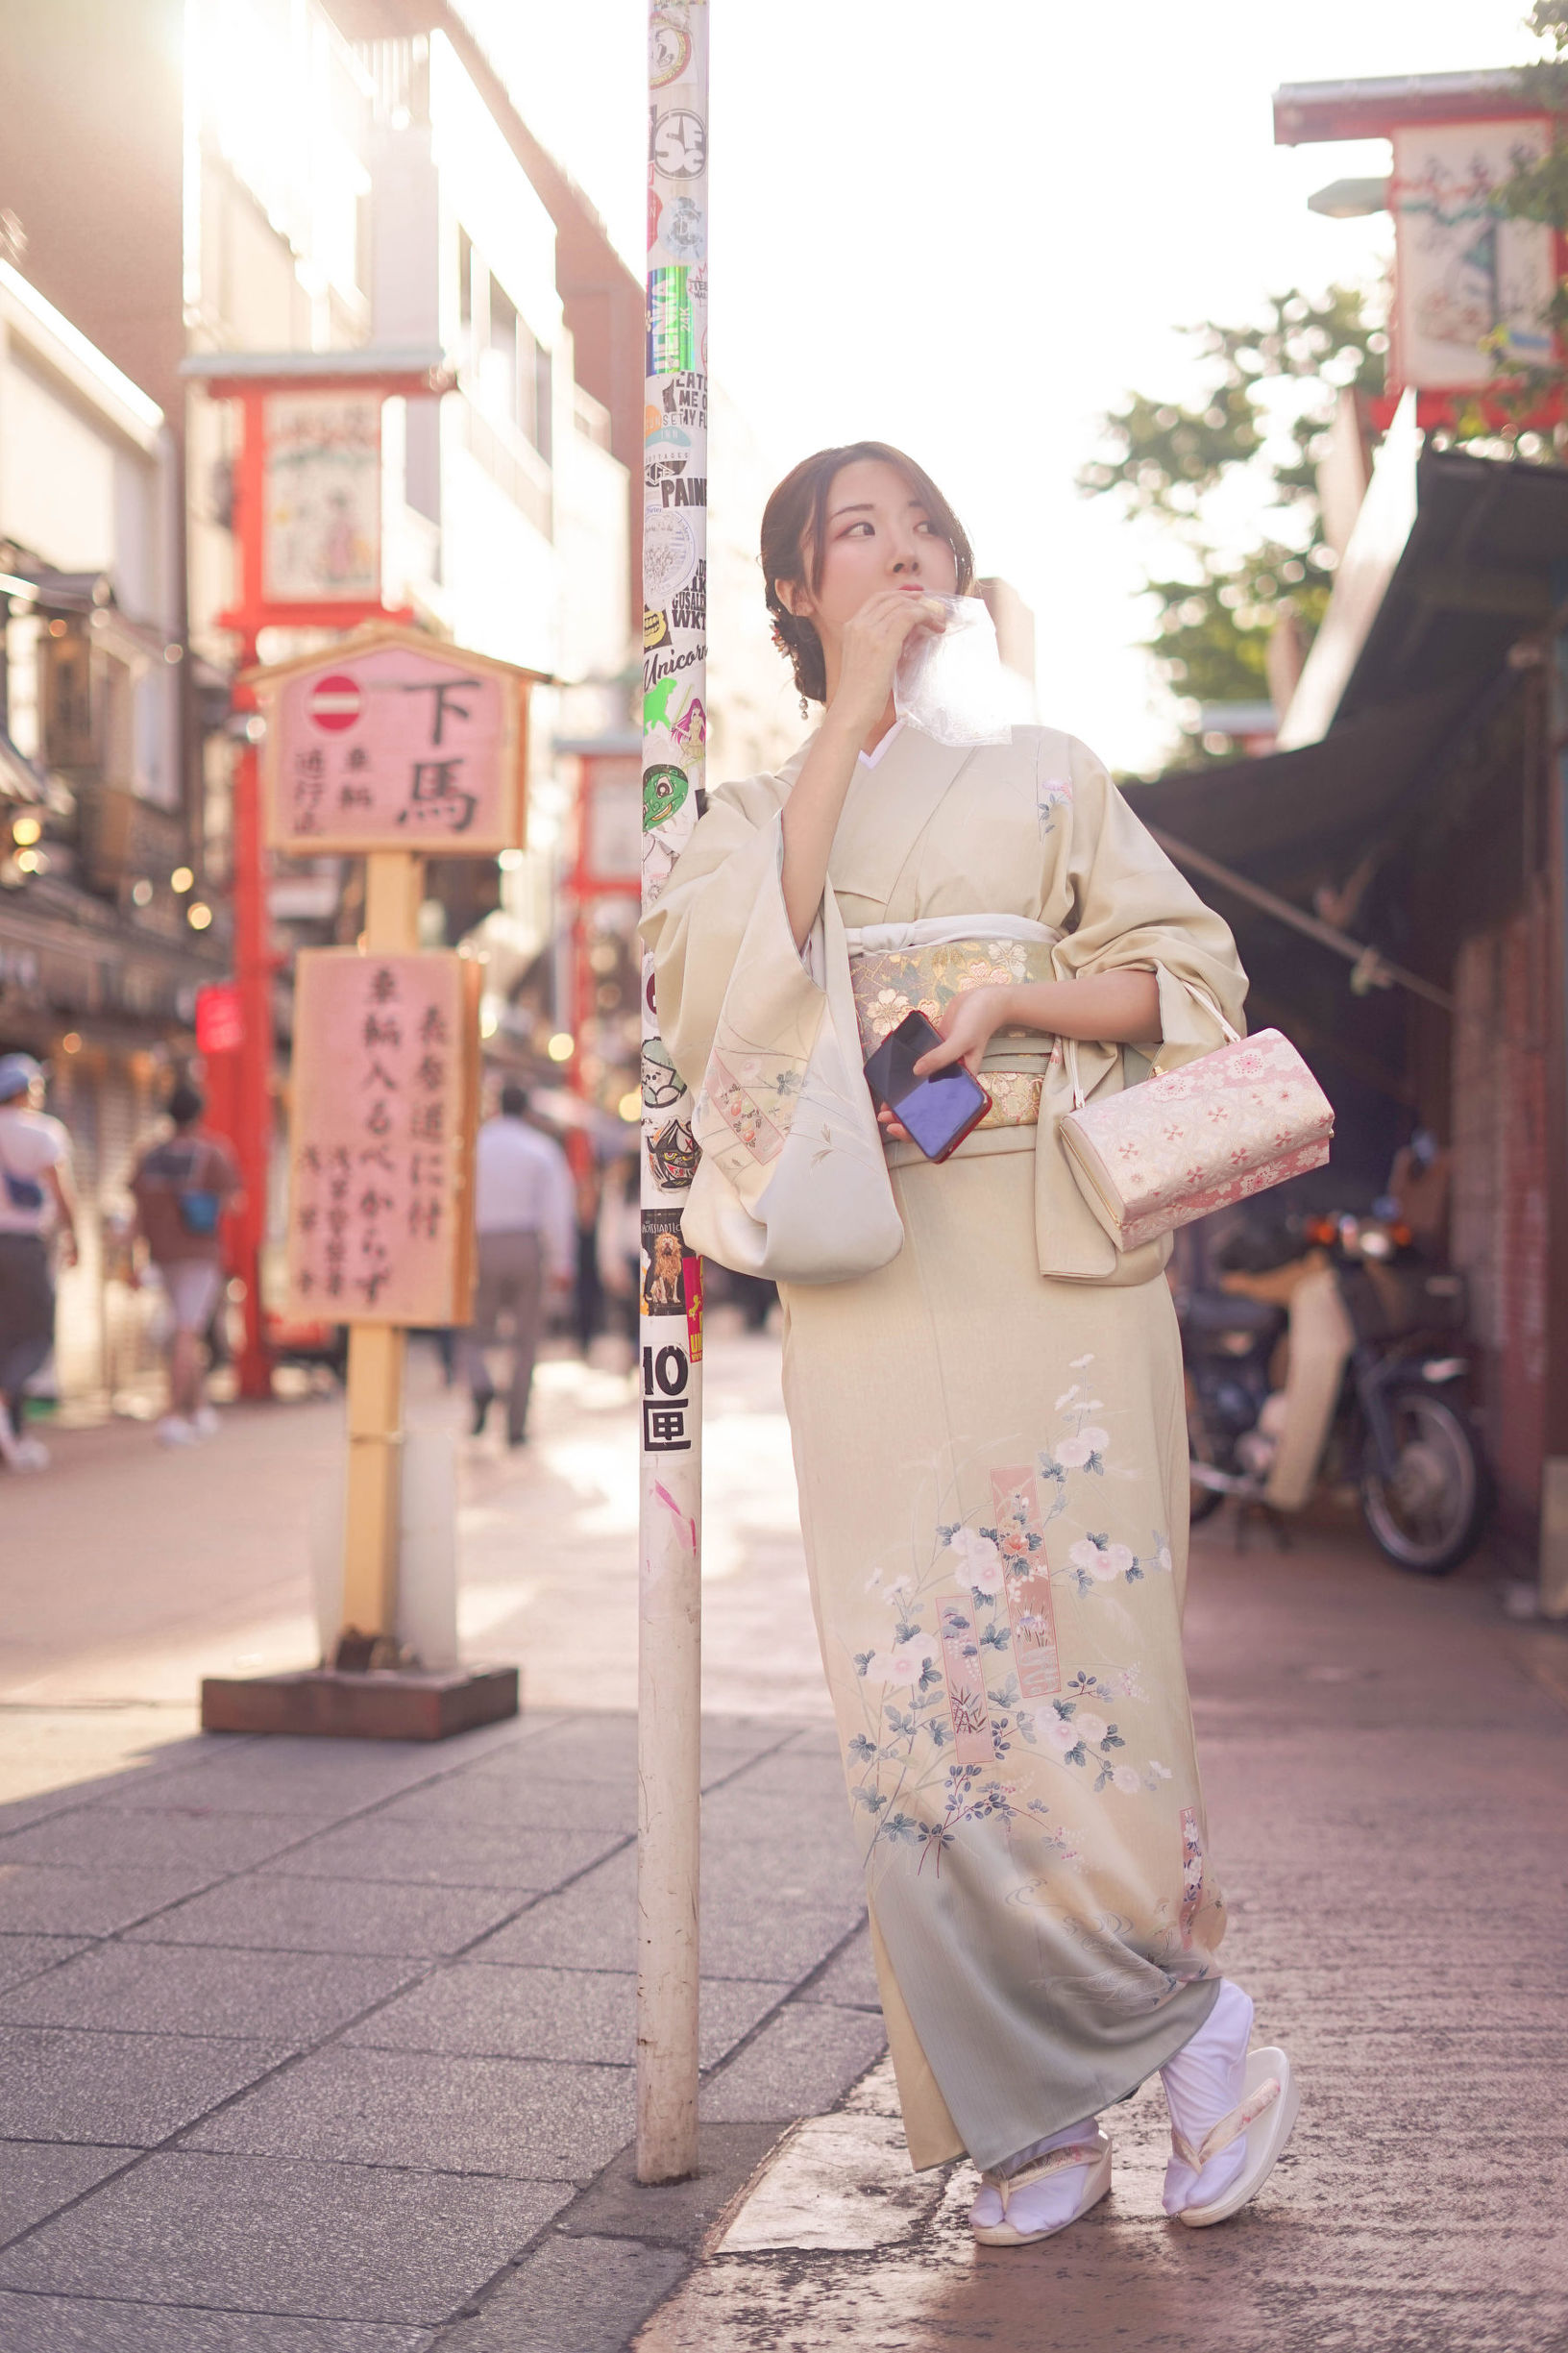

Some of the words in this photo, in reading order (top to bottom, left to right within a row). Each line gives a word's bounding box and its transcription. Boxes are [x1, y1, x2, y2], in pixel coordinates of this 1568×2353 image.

[679, 390, 698, 407] ME
[396, 679, 481, 834] 下馬
[643, 1345, 689, 1396] 10
